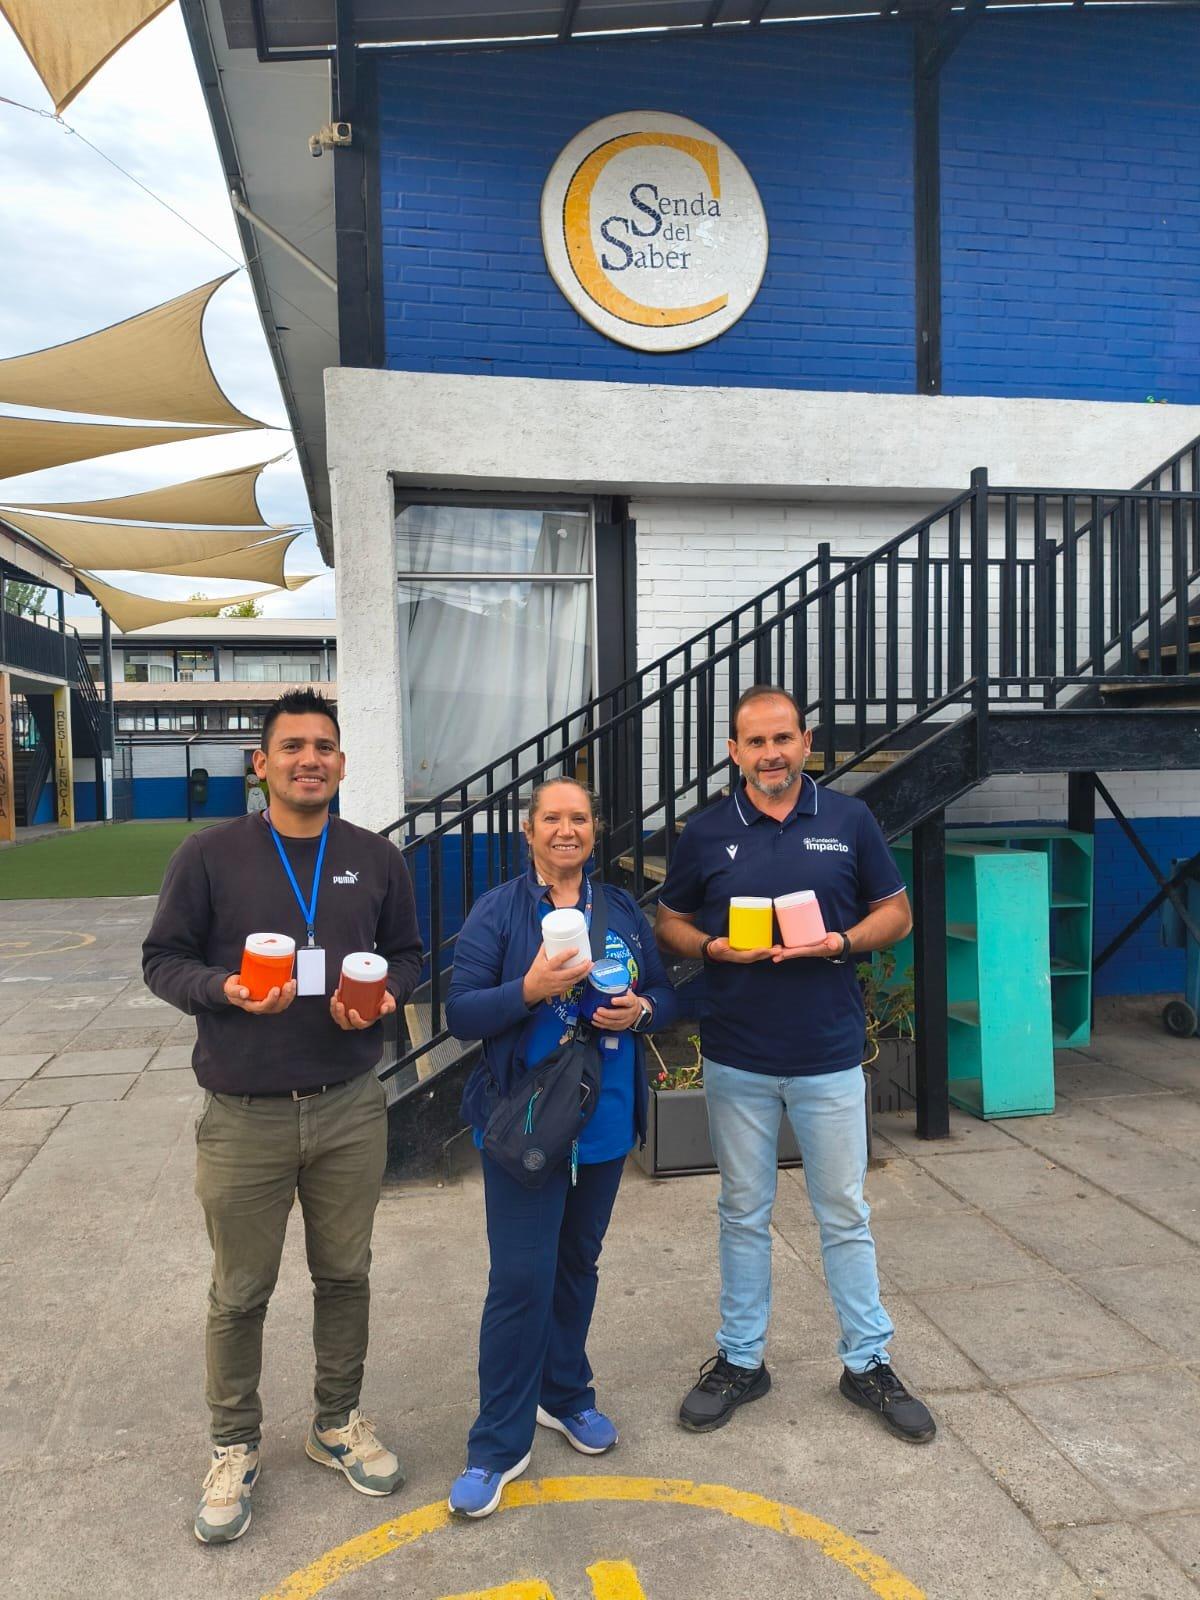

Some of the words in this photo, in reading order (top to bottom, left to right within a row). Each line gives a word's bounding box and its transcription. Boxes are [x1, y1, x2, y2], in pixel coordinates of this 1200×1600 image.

[629, 183, 721, 236] Senda
[663, 222, 691, 241] del
[600, 215, 691, 270] Saber
[56, 711, 69, 817] RESILIENCIA
